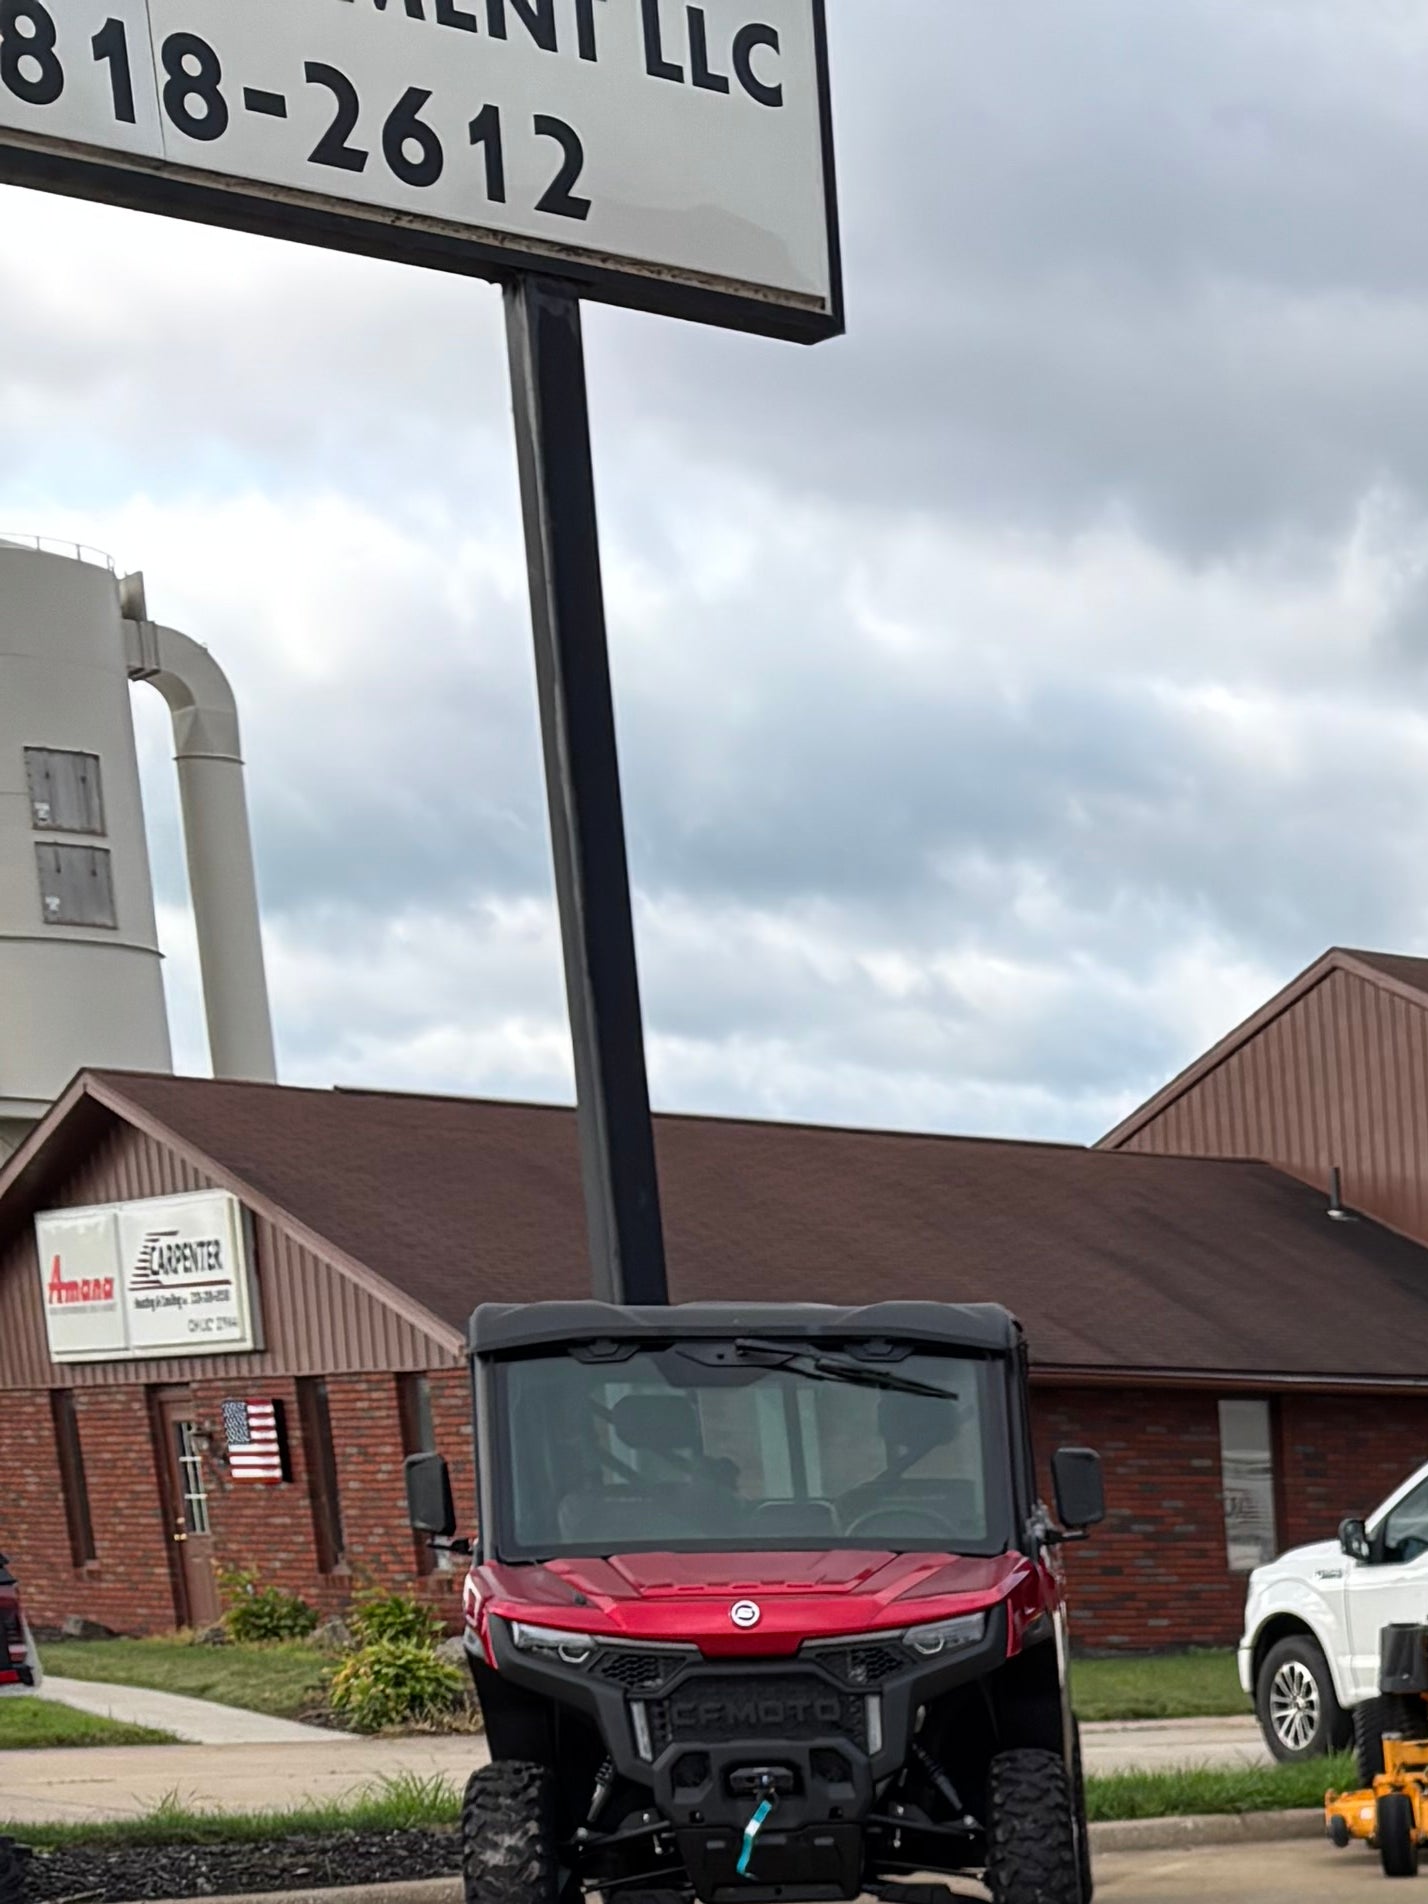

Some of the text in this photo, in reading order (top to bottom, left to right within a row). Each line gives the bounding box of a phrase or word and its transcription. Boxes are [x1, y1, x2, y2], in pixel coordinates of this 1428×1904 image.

[641, 0, 783, 107] LLC
[0, 0, 592, 221] 818-2612
[48, 1254, 114, 1304] Amana
[149, 1239, 223, 1275] CARPENTER
[672, 1696, 841, 1726] CFMOTO
